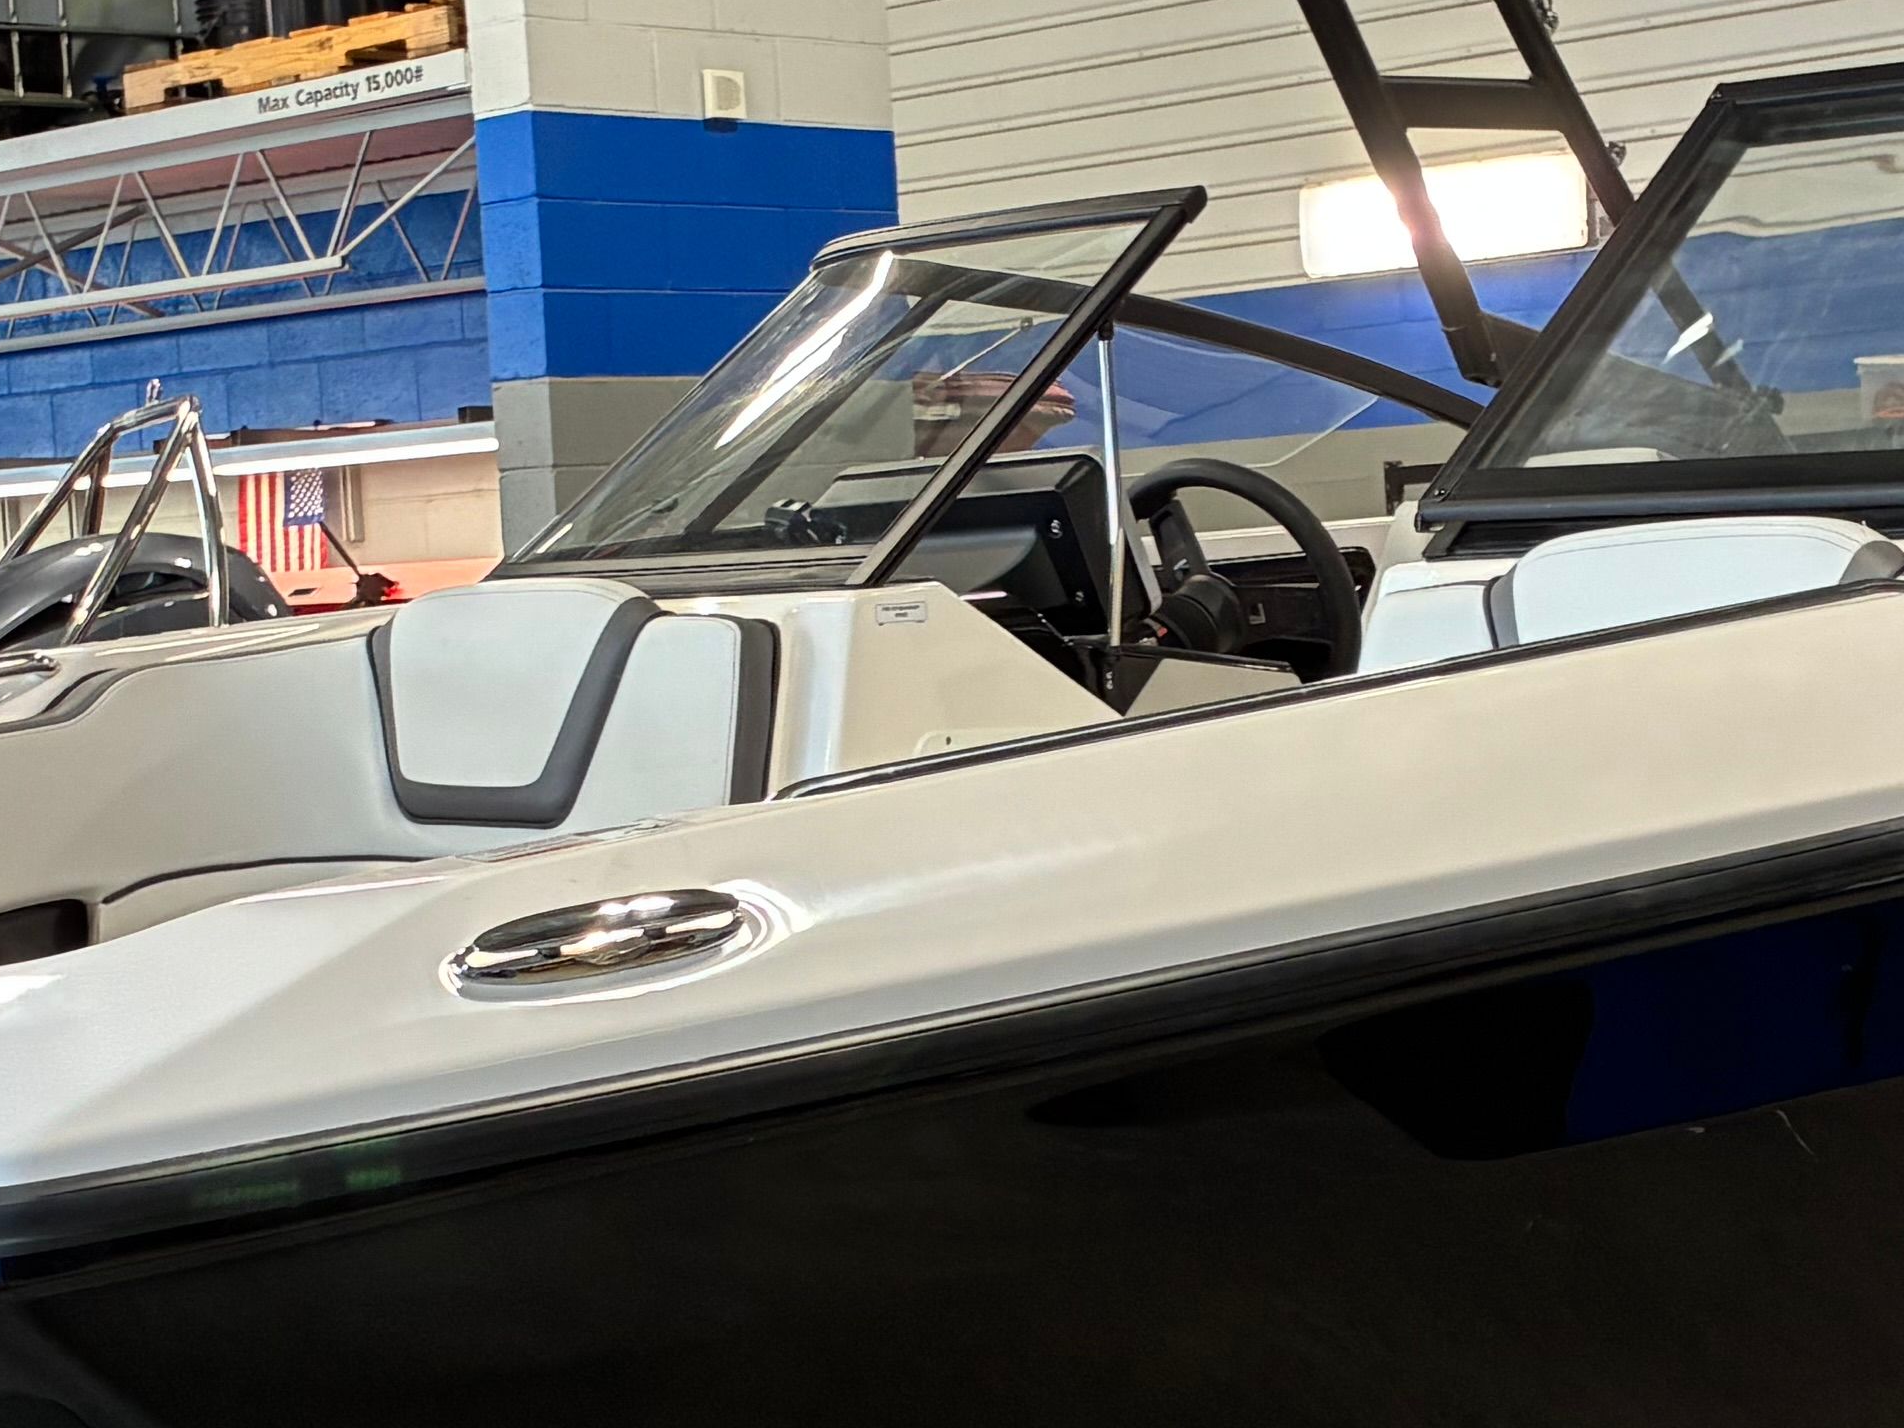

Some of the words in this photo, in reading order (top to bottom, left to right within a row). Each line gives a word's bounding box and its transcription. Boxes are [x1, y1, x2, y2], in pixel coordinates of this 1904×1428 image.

[257, 95, 290, 114] Max
[295, 80, 360, 108] Capacity
[365, 65, 424, 93] 15,000#
